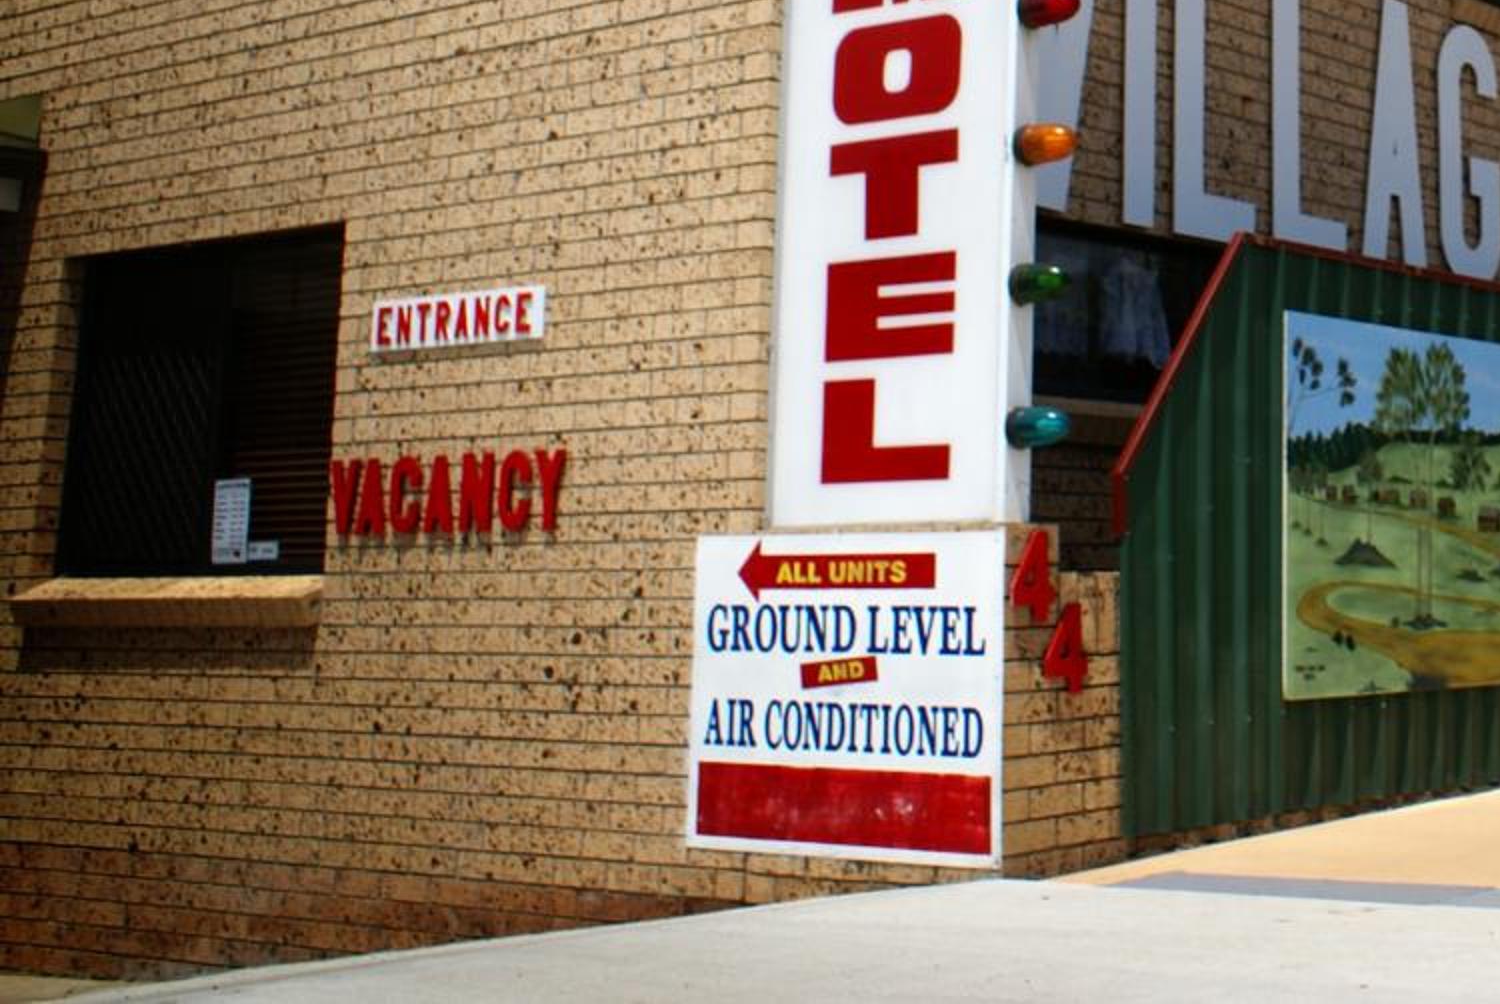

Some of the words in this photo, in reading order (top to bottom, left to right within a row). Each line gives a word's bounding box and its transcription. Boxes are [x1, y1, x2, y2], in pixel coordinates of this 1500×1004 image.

[375, 292, 534, 346] ENTRANCE
[330, 447, 568, 538] VACANCY
[776, 560, 821, 584] ALL
[829, 560, 907, 584] UNITS
[707, 604, 858, 655] GROUND
[866, 605, 986, 657] LEVEL
[817, 659, 866, 684] AND
[703, 698, 757, 748] AIR
[764, 699, 984, 759] CONDITIONED
